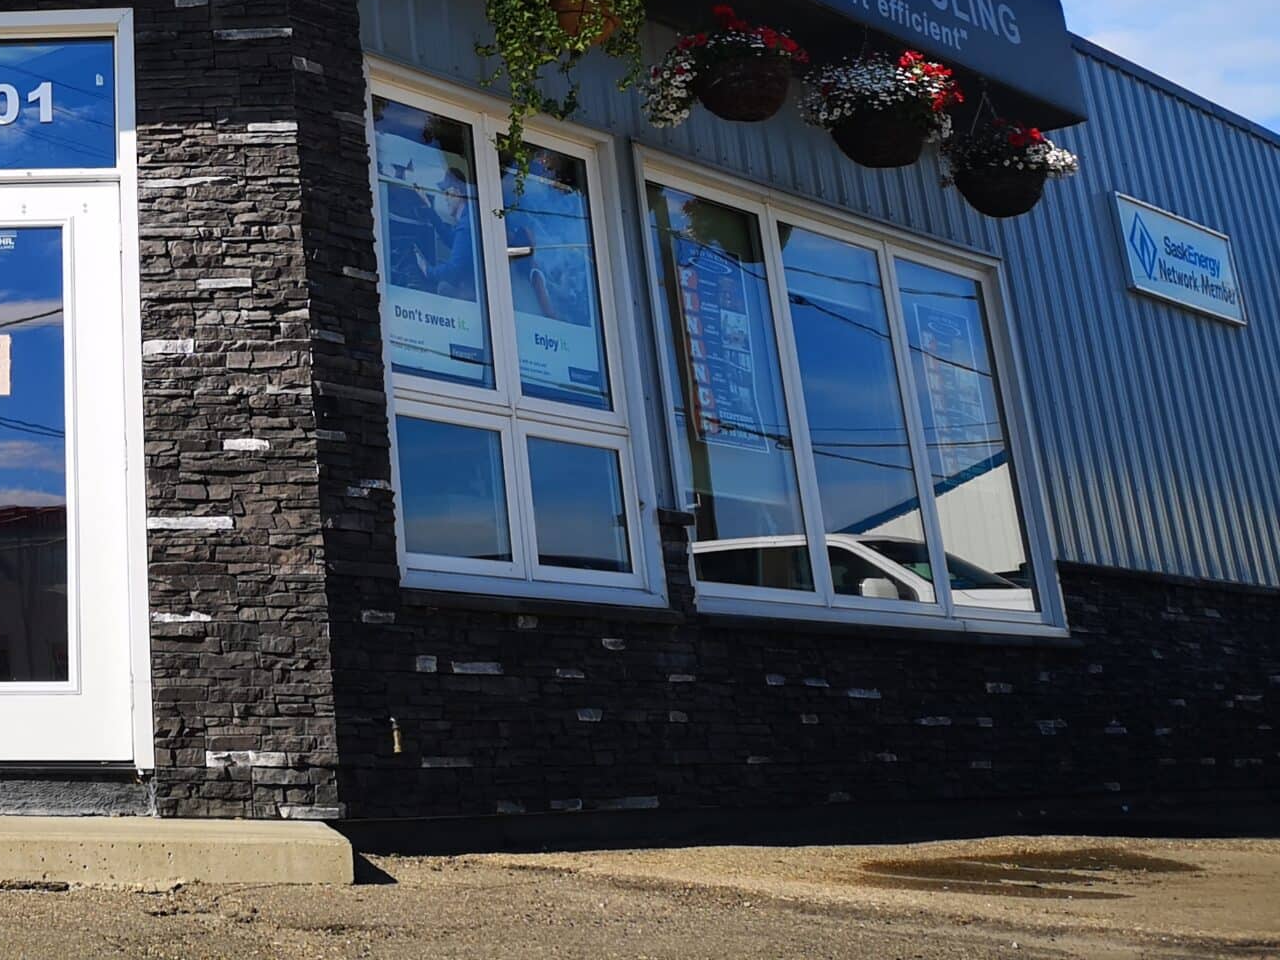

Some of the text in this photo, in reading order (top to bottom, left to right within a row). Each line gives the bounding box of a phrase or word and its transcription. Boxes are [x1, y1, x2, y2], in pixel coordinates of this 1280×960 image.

[1164, 236, 1220, 278] SaskEnergy
[1159, 258, 1200, 292] Network
[394, 304, 423, 322] Don't
[425, 313, 456, 329] sweat
[534, 332, 559, 352] Enjoy
